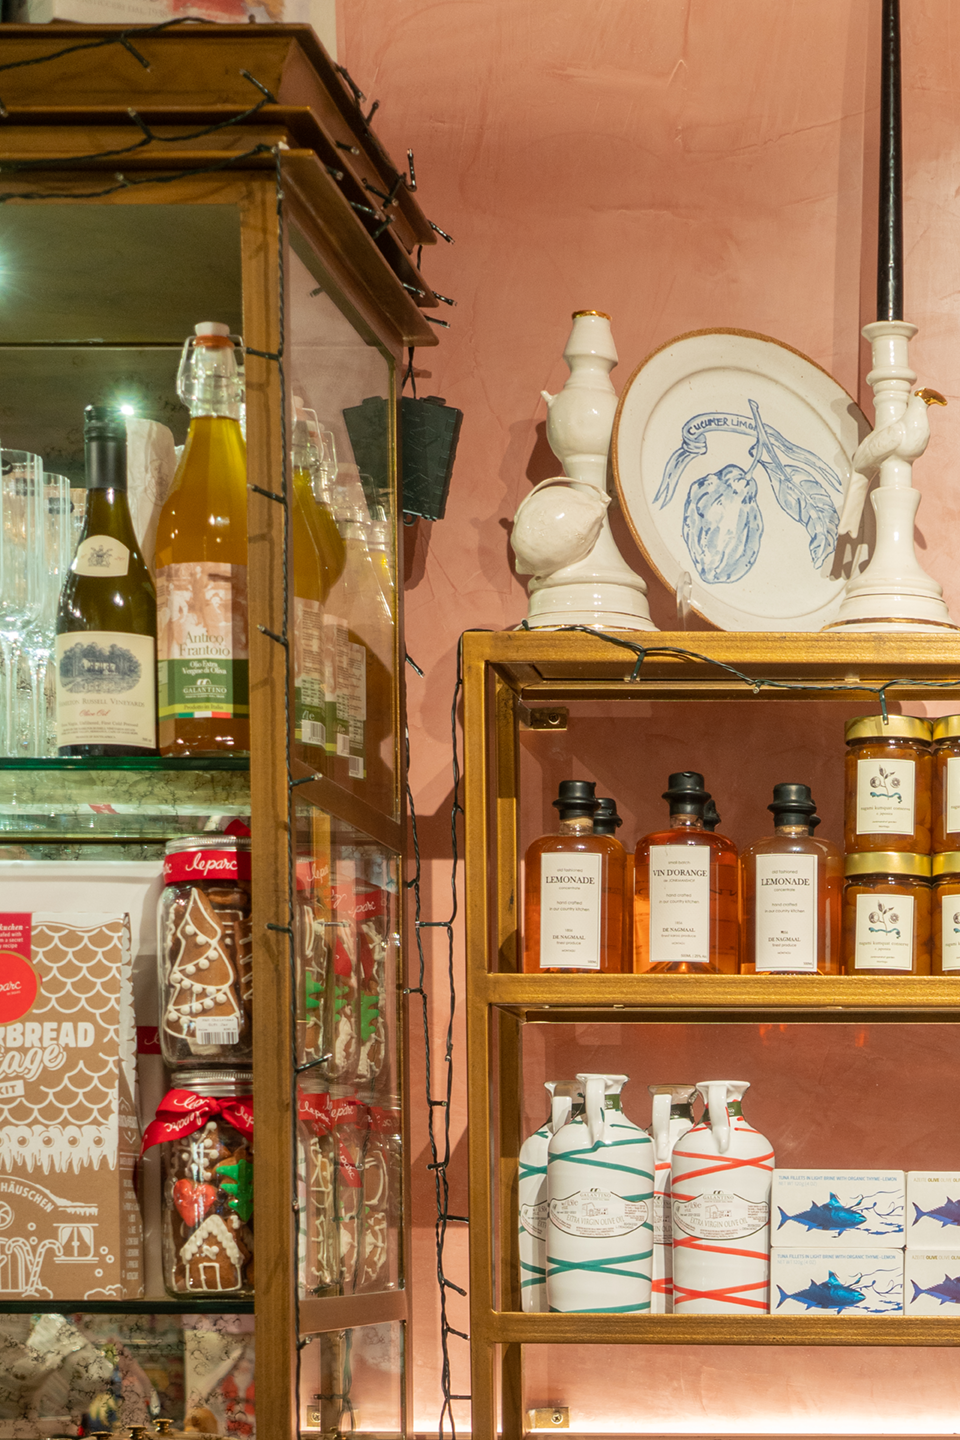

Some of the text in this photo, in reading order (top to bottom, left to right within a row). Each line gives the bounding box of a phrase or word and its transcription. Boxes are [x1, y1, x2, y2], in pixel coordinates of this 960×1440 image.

[688, 417, 729, 435] CUCUMER
[186, 631, 224, 644] Antico
[179, 645, 230, 657] Frantoio
[183, 686, 227, 694] GALANTINO
[110, 698, 145, 708] VINEYARDS
[185, 853, 238, 876] leparc
[667, 869, 708, 877] D'ORANGE
[546, 876, 595, 885] LEMONADE
[761, 878, 810, 886] LEMONADE
